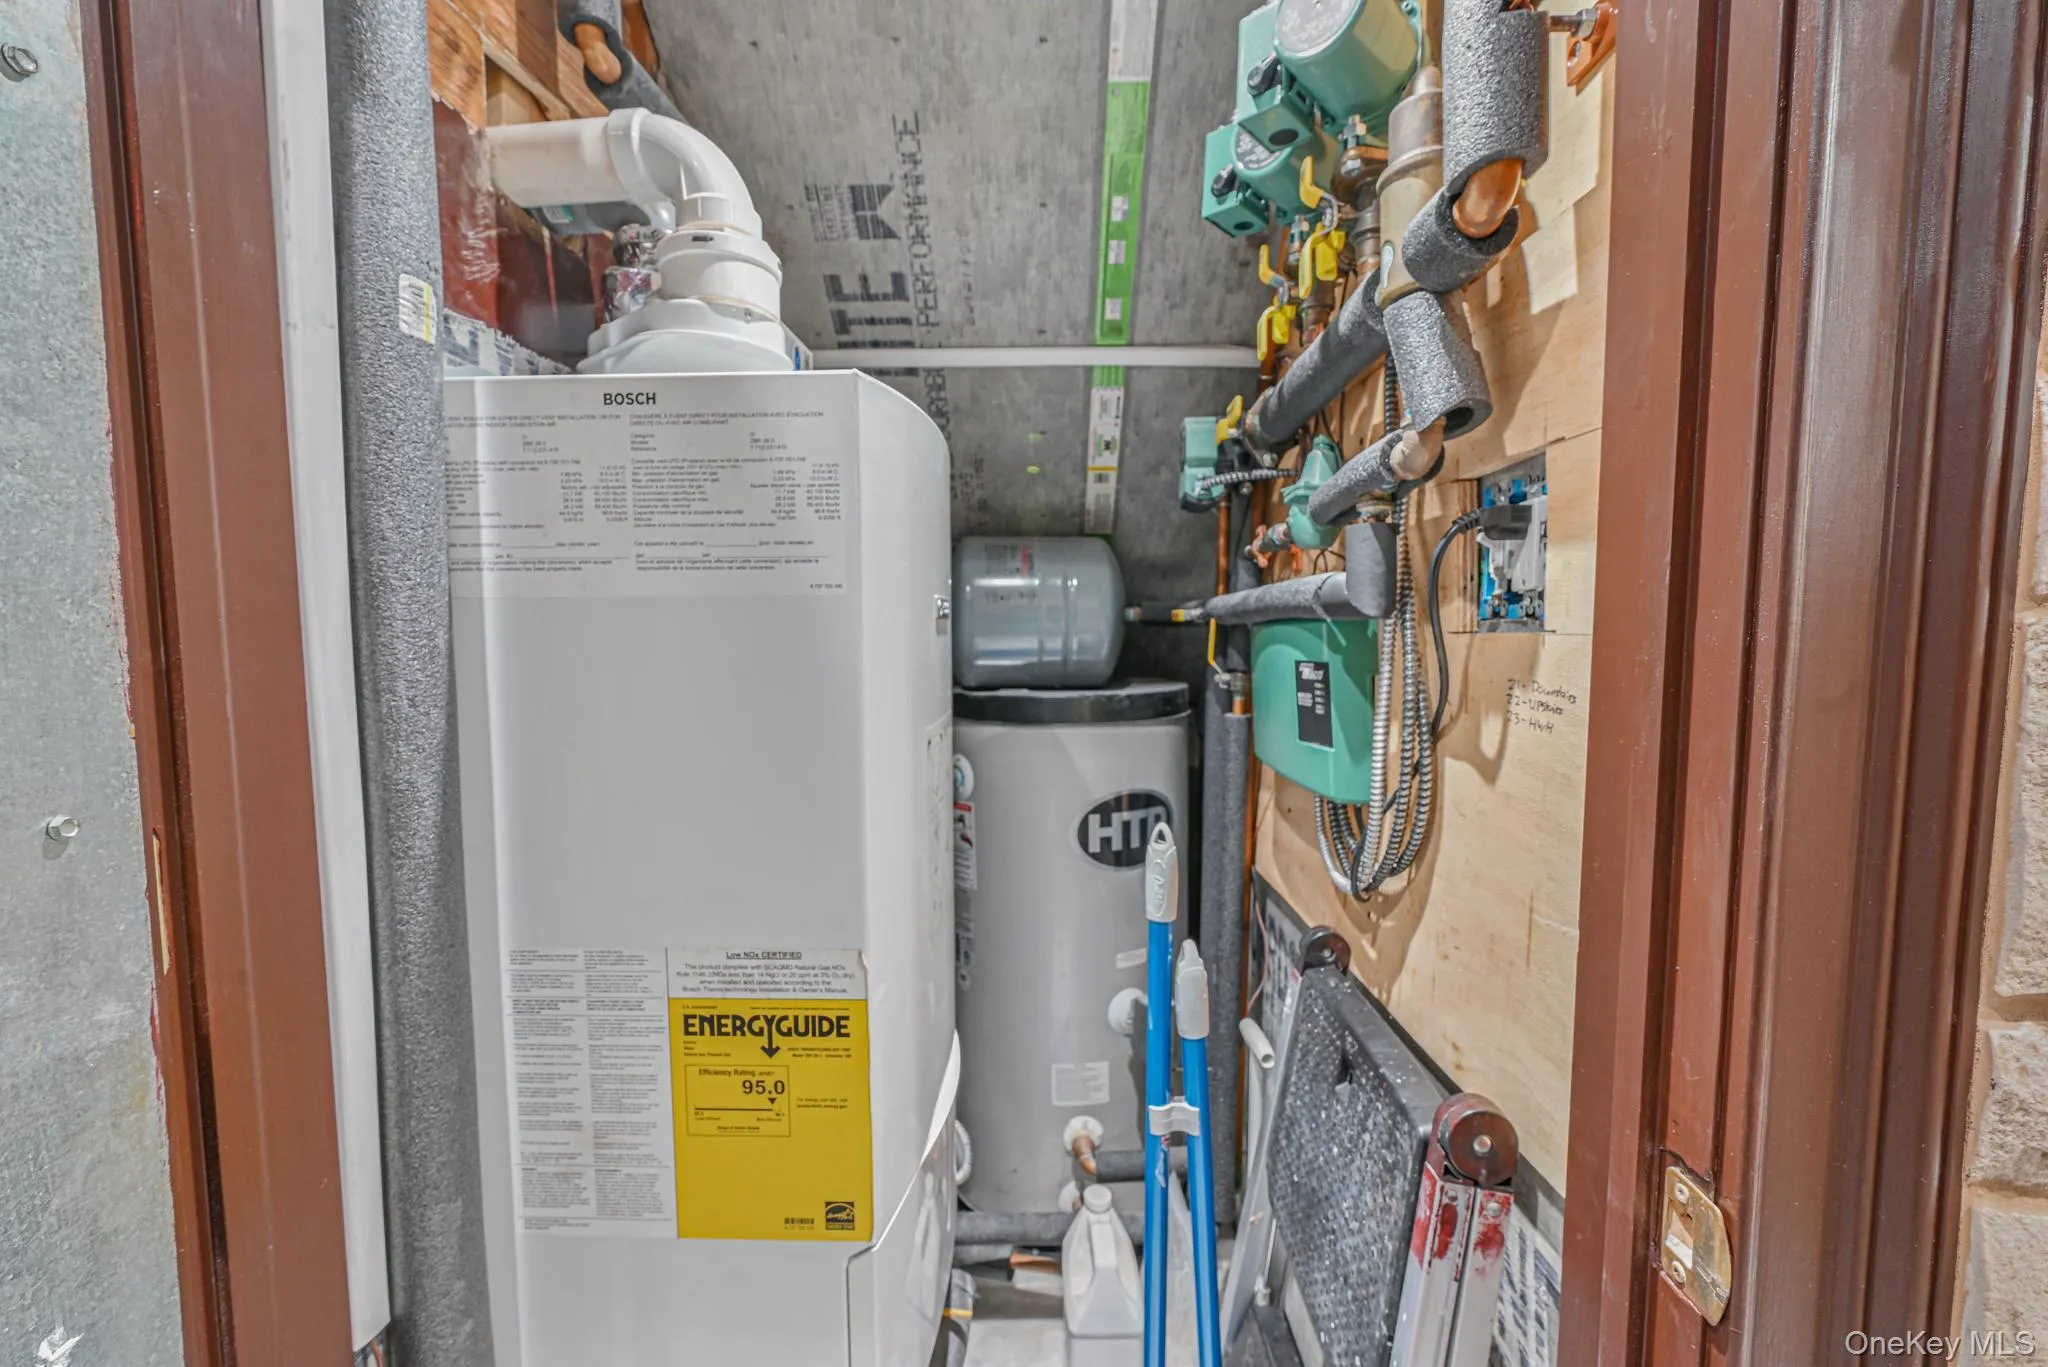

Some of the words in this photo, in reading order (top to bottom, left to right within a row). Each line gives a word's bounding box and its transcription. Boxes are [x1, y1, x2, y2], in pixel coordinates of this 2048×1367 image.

[603, 391, 657, 406] BOSCH
[726, 951, 742, 960] Low
[761, 951, 802, 960] CERTIFIED
[683, 1014, 851, 1038] ENERGYGUIDE
[698, 1068, 731, 1077] Efficiency
[733, 1068, 756, 1078] Rating
[742, 1079, 785, 1095] 95.0
